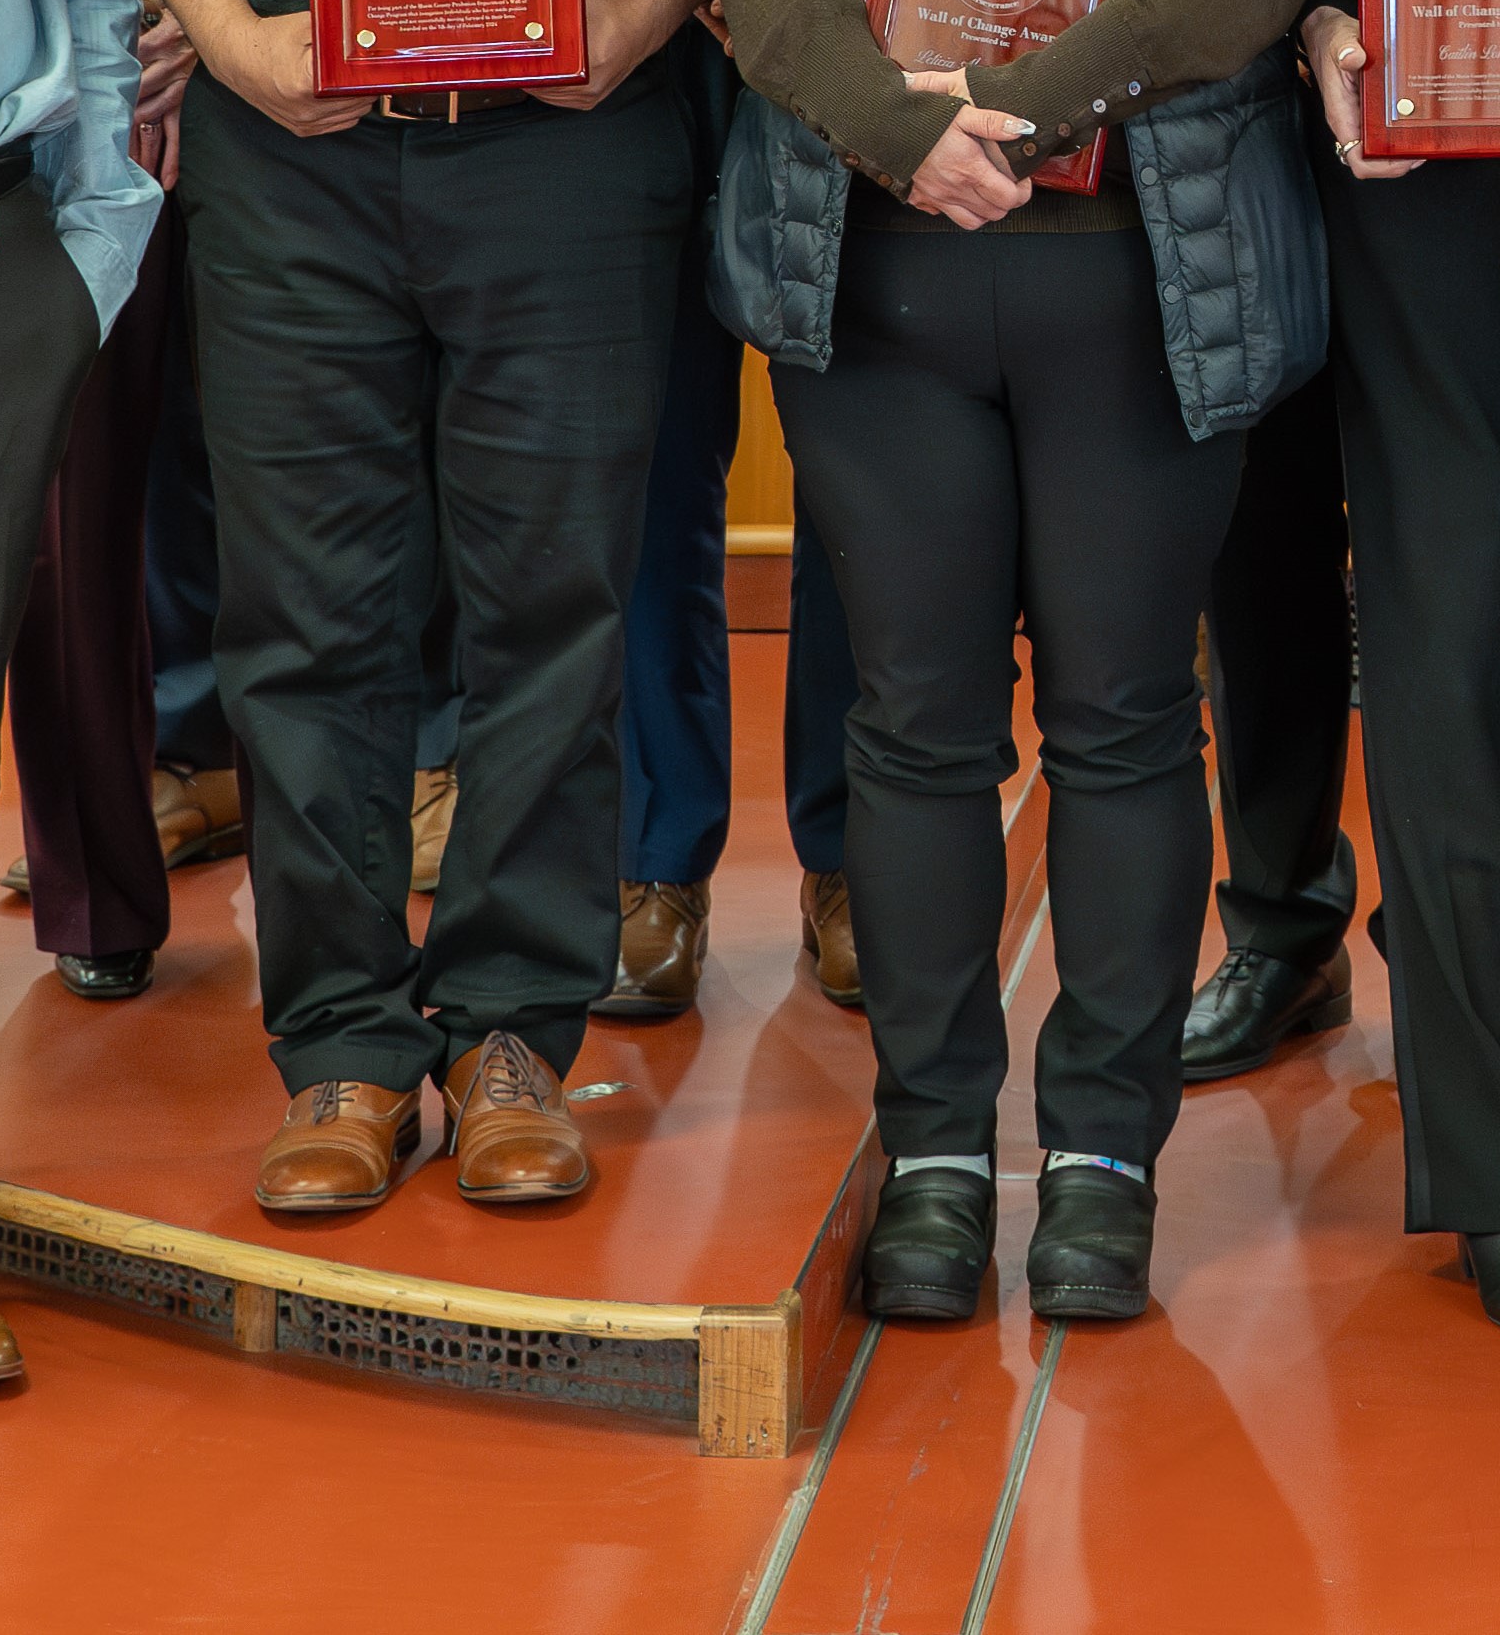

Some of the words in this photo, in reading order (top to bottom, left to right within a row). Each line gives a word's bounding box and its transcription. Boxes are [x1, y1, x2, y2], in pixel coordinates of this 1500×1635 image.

[1412, 5, 1442, 18] Wall
[1445, 5, 1459, 17] of
[917, 7, 948, 24] Wall
[950, 15, 965, 27] of
[967, 16, 1017, 39] Change
[1020, 27, 1057, 44] Awar
[1458, 21, 1495, 29] Presented
[961, 32, 999, 46] Presented
